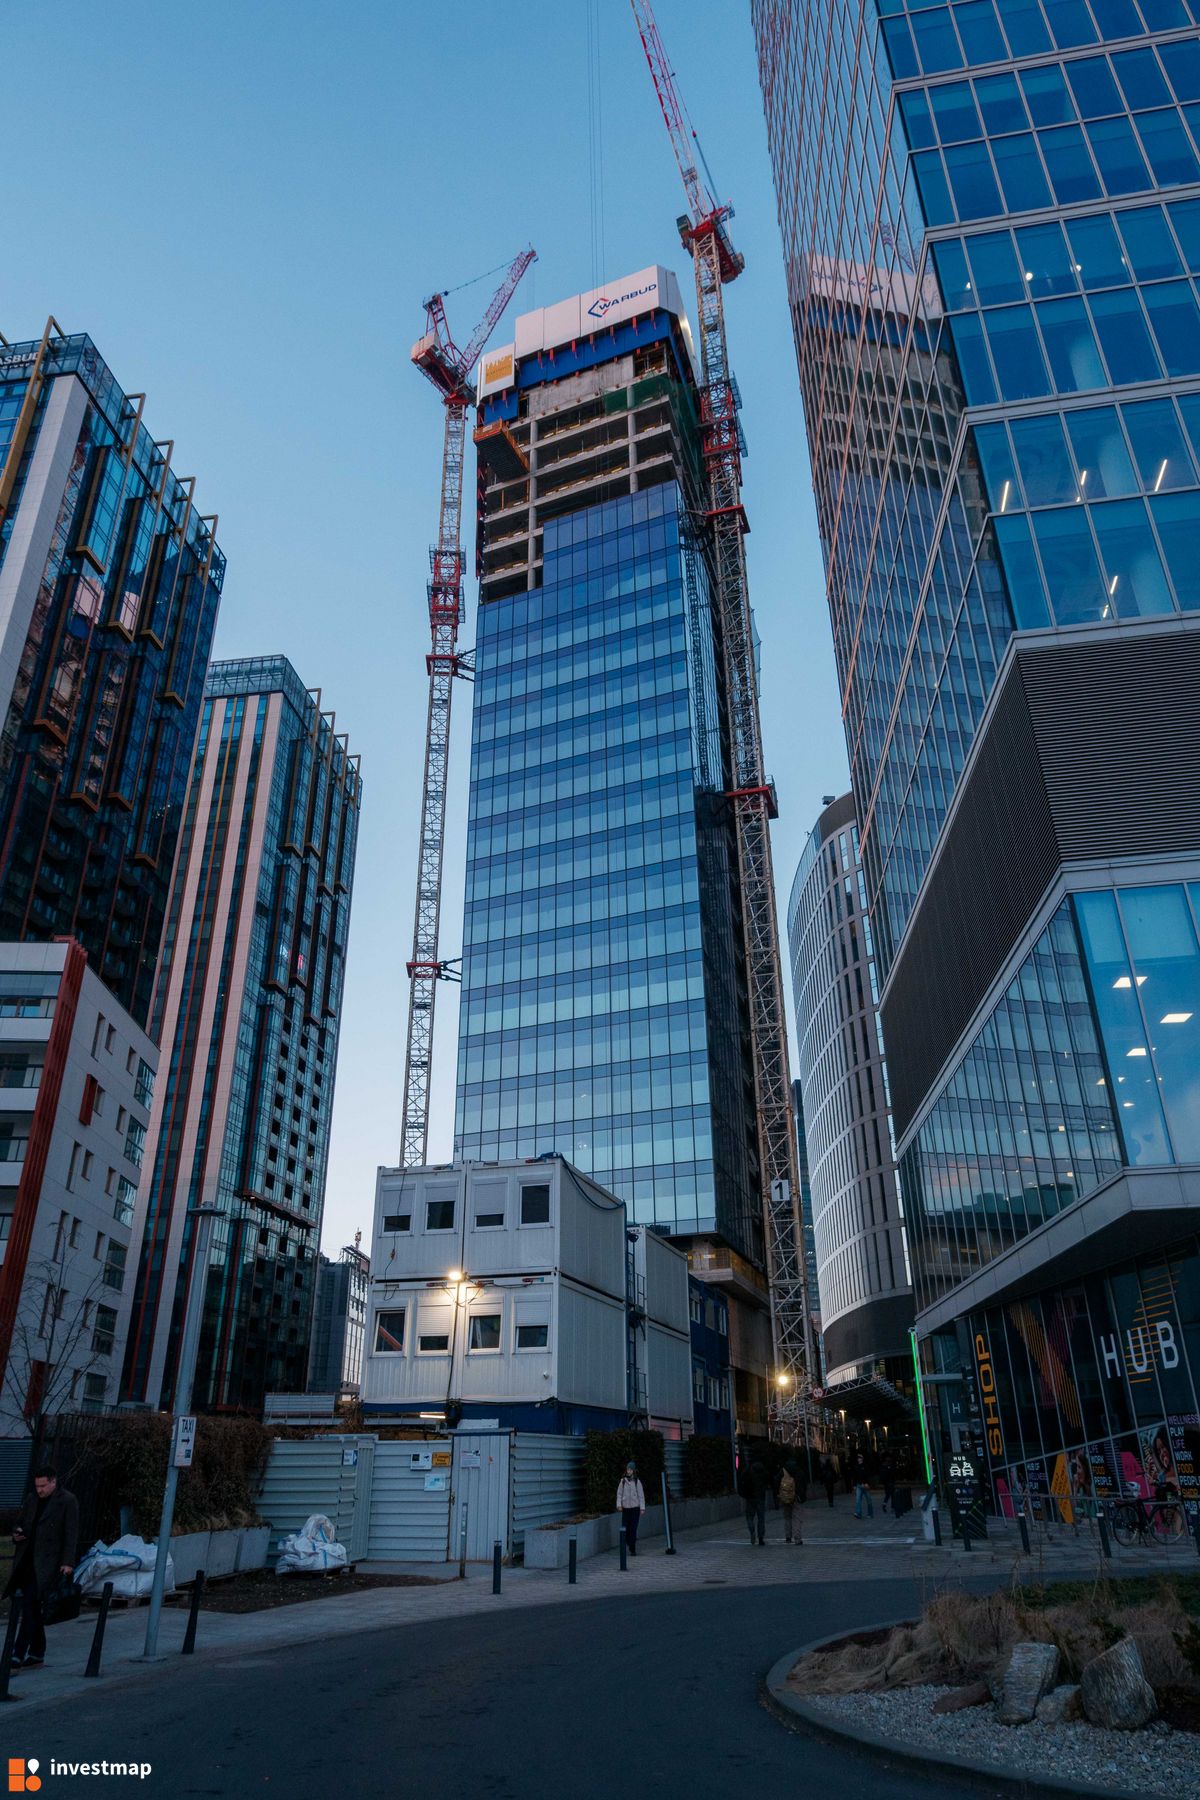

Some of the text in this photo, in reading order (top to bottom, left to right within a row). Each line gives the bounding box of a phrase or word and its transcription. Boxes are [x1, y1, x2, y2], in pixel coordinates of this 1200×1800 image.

[599, 284, 657, 310] WARBUD
[774, 1181, 784, 1200] 1
[1100, 1320, 1179, 1378] HUB
[975, 1333, 1004, 1457] SHOP
[1167, 1414, 1200, 1425] WELLNESS
[182, 1419, 194, 1433] TAXI
[1169, 1426, 1185, 1437] PLAY
[1172, 1438, 1186, 1449] LIFE
[1174, 1450, 1193, 1461] WORK
[1177, 1463, 1195, 1474] FOOD
